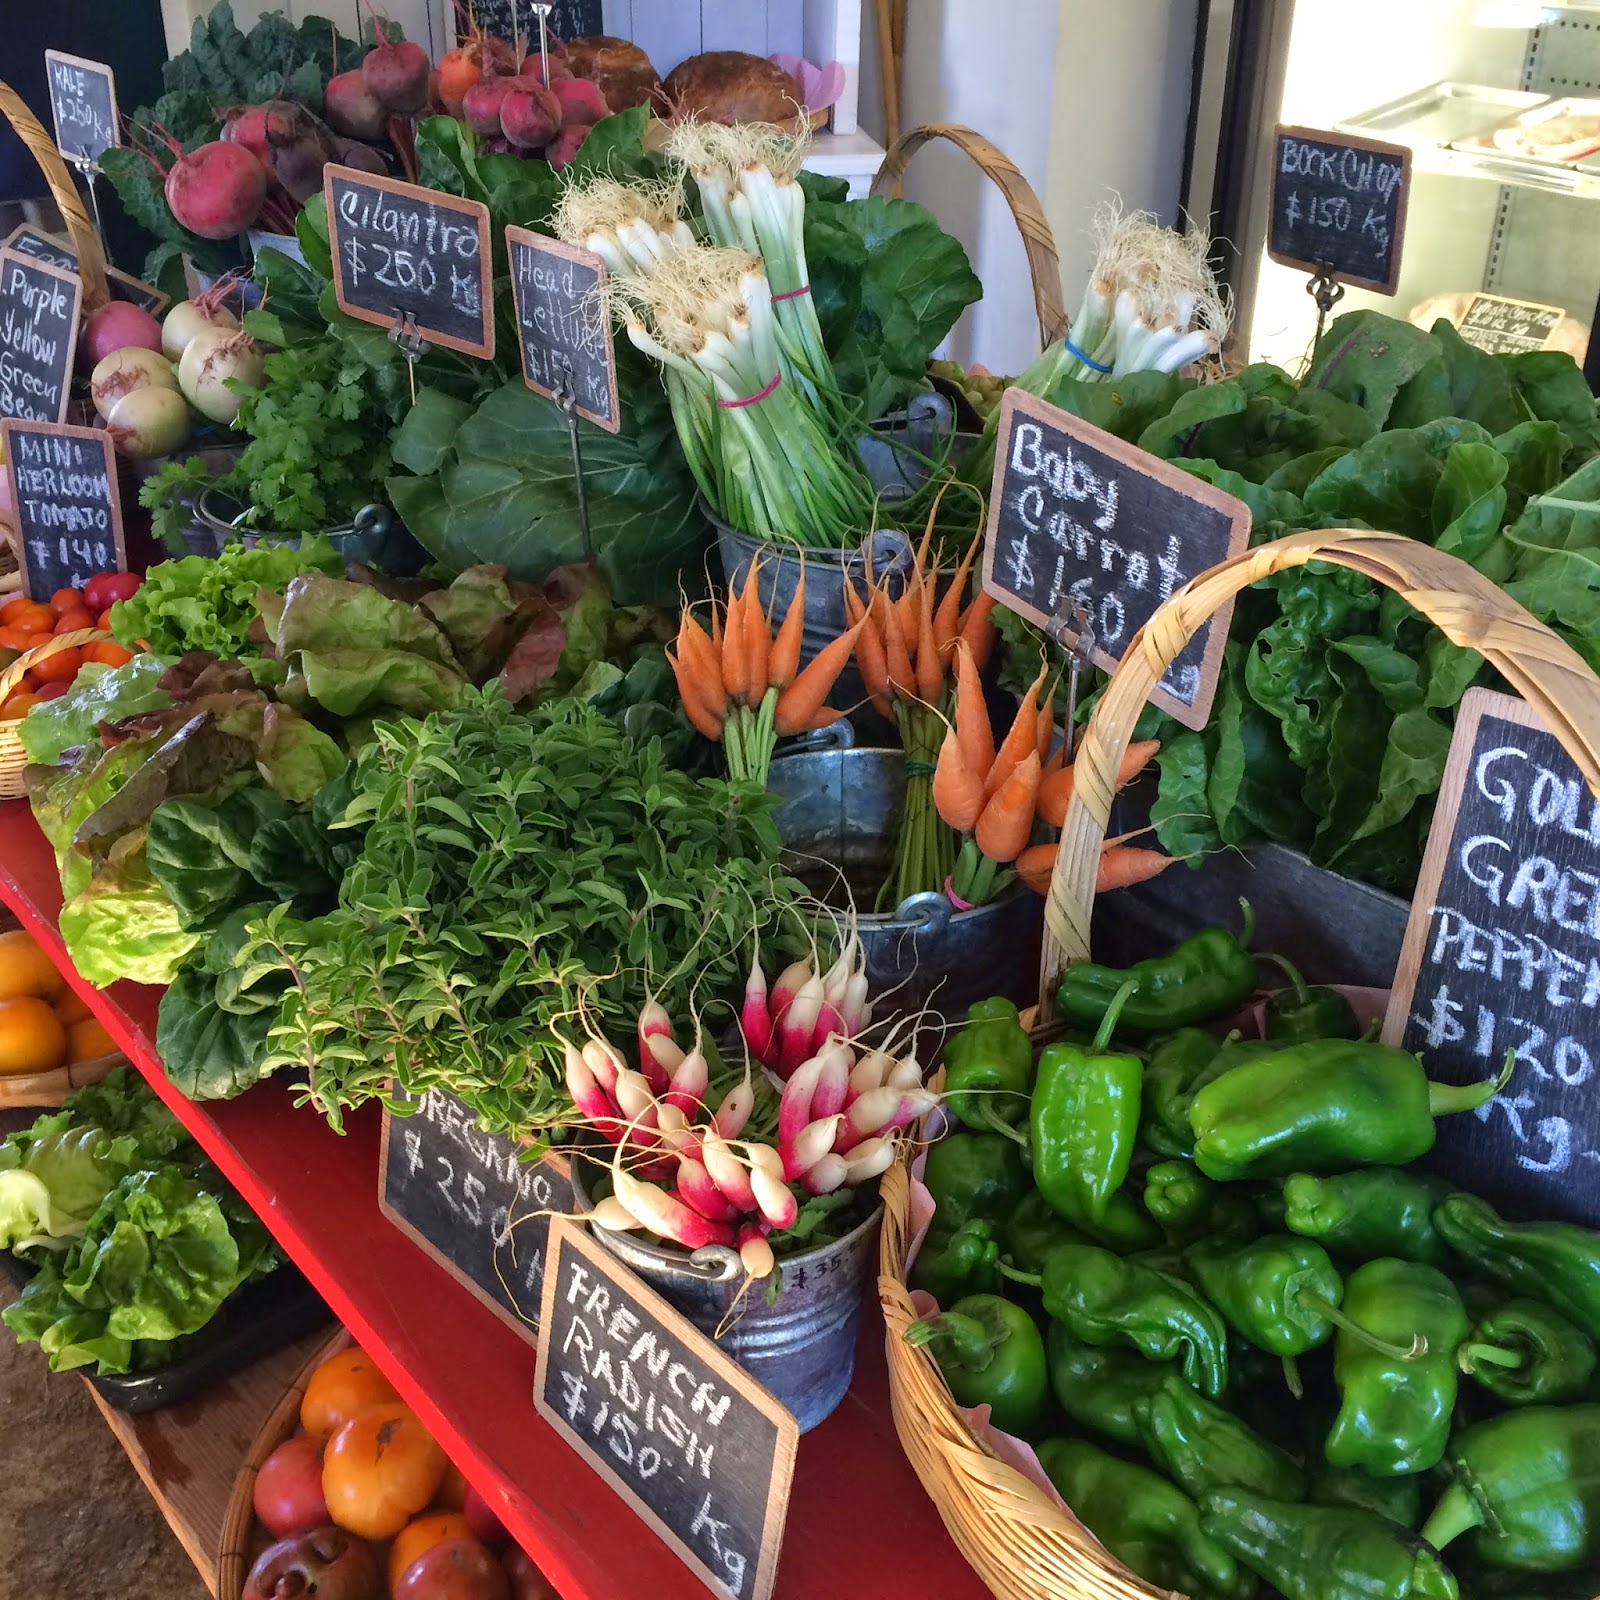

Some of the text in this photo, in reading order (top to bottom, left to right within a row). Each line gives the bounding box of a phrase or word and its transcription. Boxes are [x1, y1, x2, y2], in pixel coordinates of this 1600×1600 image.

[54, 63, 85, 97] KALE
[57, 93, 92, 127] $250
[338, 190, 479, 258] Cilantro
[1285, 191, 1390, 259] $150 Kg
[10, 268, 68, 325] Purple
[343, 236, 437, 296] $250
[519, 245, 577, 300] Head
[0, 308, 57, 366] Yellow
[0, 351, 57, 405] Green
[19, 434, 83, 469] MINI
[1011, 423, 1119, 532] Baby
[24, 500, 109, 532] TOMATO
[1017, 485, 1188, 602] Carrot
[1475, 746, 1600, 848] GOL
[1461, 834, 1600, 941] GRE
[566, 1262, 732, 1426] FRENCH
[562, 1315, 715, 1480] RADISH
[690, 1491, 748, 1597] Kg
